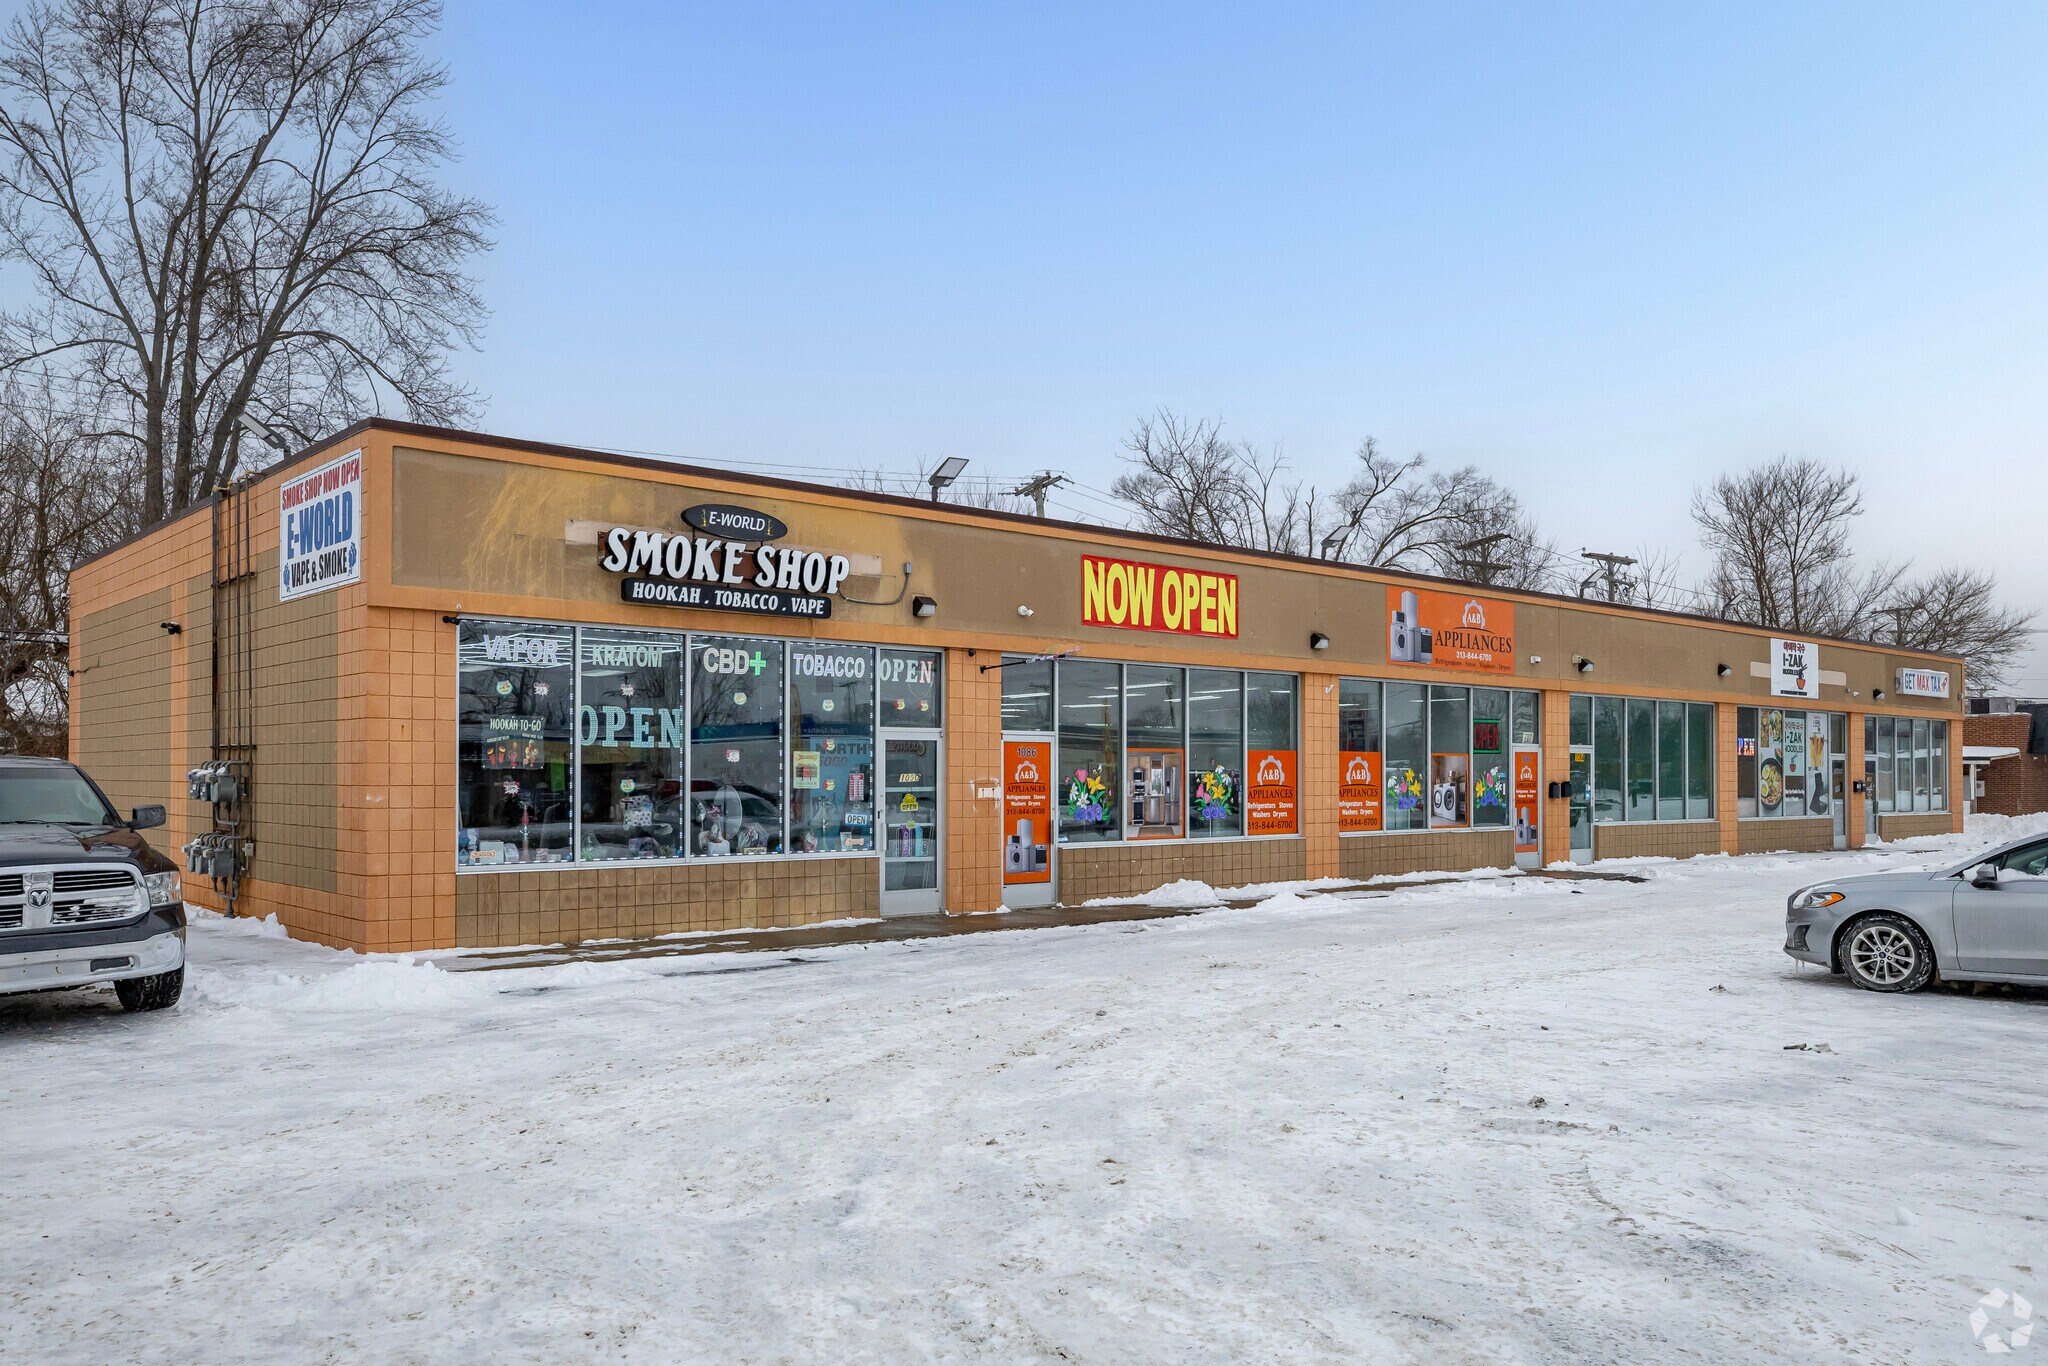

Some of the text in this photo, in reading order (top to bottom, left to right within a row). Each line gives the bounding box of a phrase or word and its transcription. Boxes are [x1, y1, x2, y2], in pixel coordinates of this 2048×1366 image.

[282, 457, 360, 511] SMOKE SHOP NOW OPEN
[287, 490, 353, 560] E-WORLD
[708, 511, 766, 532] E-WORLD
[291, 547, 348, 588] VAPE & SMOKE
[602, 527, 850, 594] SMOKE SHOP
[632, 582, 825, 615] HOOKAH TOBACCO VAPE
[1083, 559, 1237, 635] NOW OPEN
[1467, 613, 1482, 625] A&B
[483, 634, 558, 665] VAPOR
[1434, 630, 1512, 653] APPLIANCES
[592, 644, 663, 668] KRATOM
[793, 653, 866, 678] TOBACCO
[1783, 653, 1804, 668] I-ZAK
[880, 658, 933, 684] OPEN
[1904, 672, 1942, 692] GET MAX TAX
[490, 718, 542, 731] HOOKAH TO-GO
[581, 704, 683, 749] OPEN
[1474, 723, 1500, 750] OPEN
[1737, 737, 1755, 756] PEN
[1785, 731, 1803, 744] I-ZAK
[1017, 747, 1037, 758] 1086
[1020, 770, 1035, 779] A&B
[1263, 769, 1280, 781] A&B
[1351, 769, 1367, 780] A&B
[1007, 785, 1046, 793] APPLIANCES
[1248, 789, 1294, 799] APPLIANCES
[847, 814, 866, 825] OPEN
[1339, 818, 1378, 827] 13-844-6700
